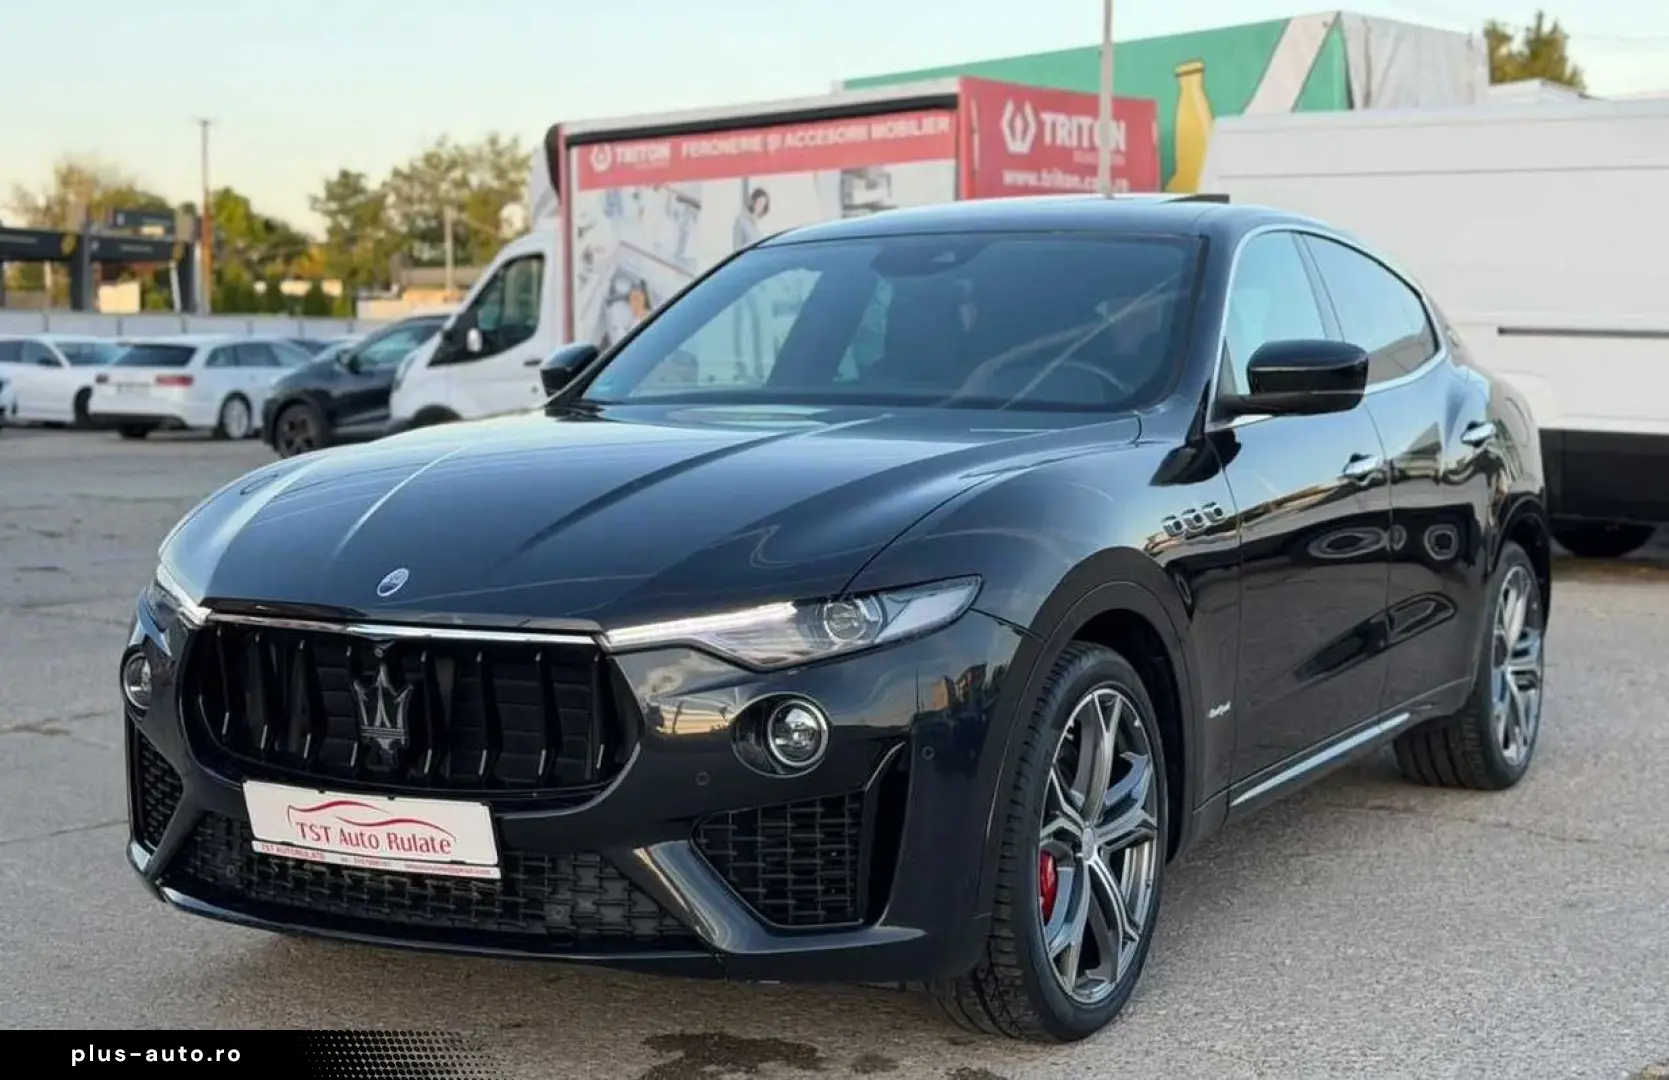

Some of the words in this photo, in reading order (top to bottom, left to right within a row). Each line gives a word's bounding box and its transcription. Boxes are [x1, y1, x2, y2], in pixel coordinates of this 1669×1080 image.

[615, 142, 671, 164] TRITON
[296, 821, 331, 843] TST
[339, 827, 379, 850] Auto
[386, 831, 452, 855] Rulate
